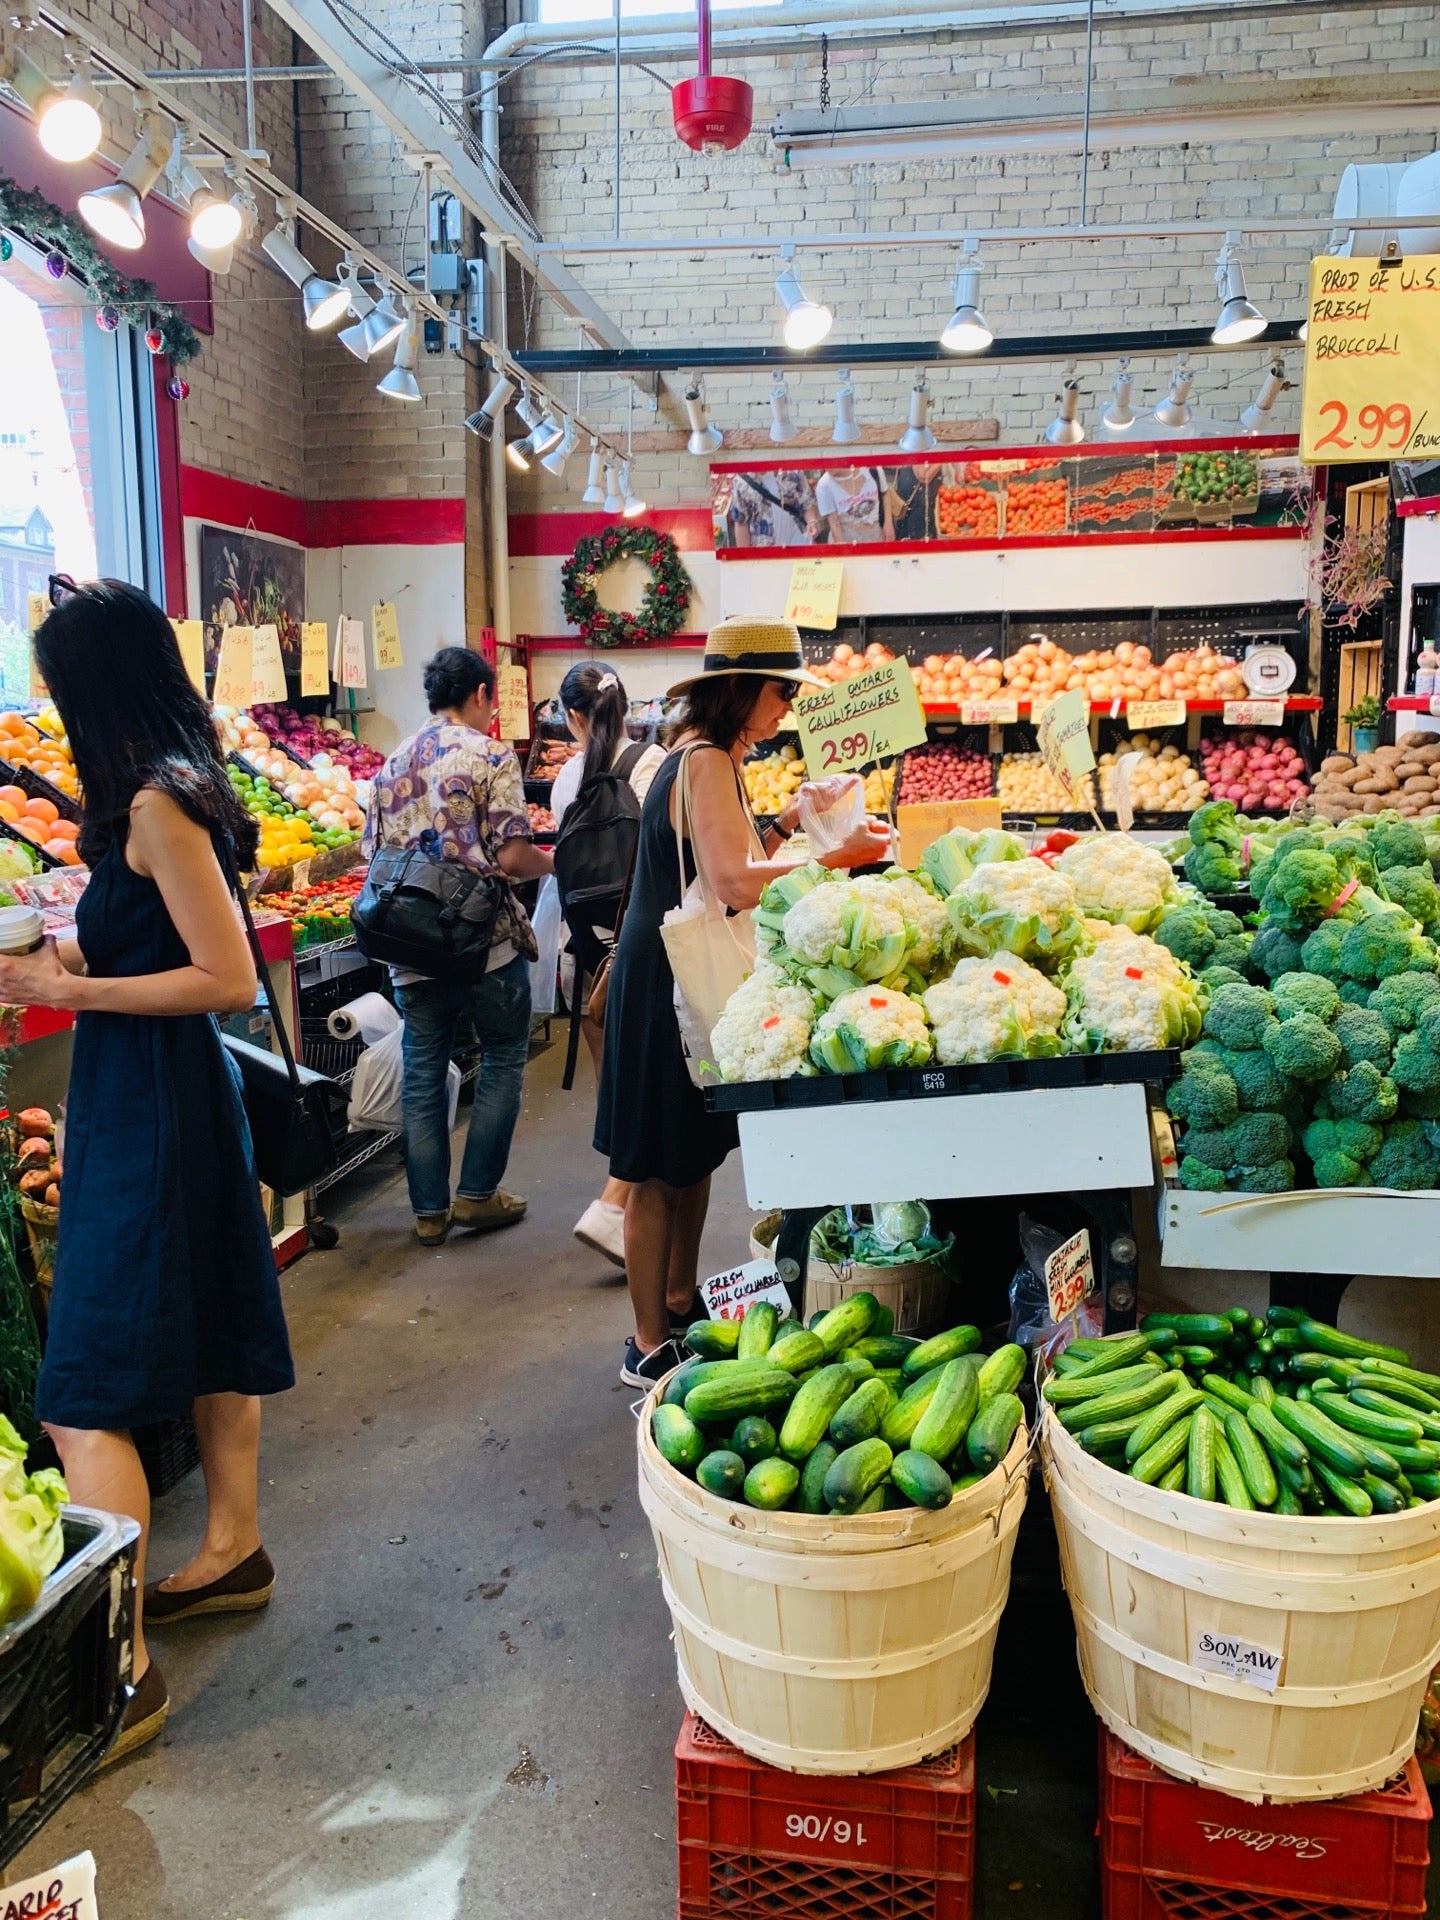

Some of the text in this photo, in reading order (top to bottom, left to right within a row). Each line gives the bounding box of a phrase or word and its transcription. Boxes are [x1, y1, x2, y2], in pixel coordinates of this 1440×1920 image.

[1321, 269, 1360, 290] PROD
[1369, 269, 1390, 290] OF
[1312, 299, 1372, 323] FRESH
[1316, 334, 1399, 359] BROCCOLI
[797, 668, 894, 713] FRESH ONTARIO
[808, 687, 900, 733] CAULIFLOWERS
[922, 1072, 945, 1082] IFCO
[924, 1080, 945, 1090] 6419
[708, 1269, 744, 1292] FRESH
[708, 1291, 733, 1311] DILL
